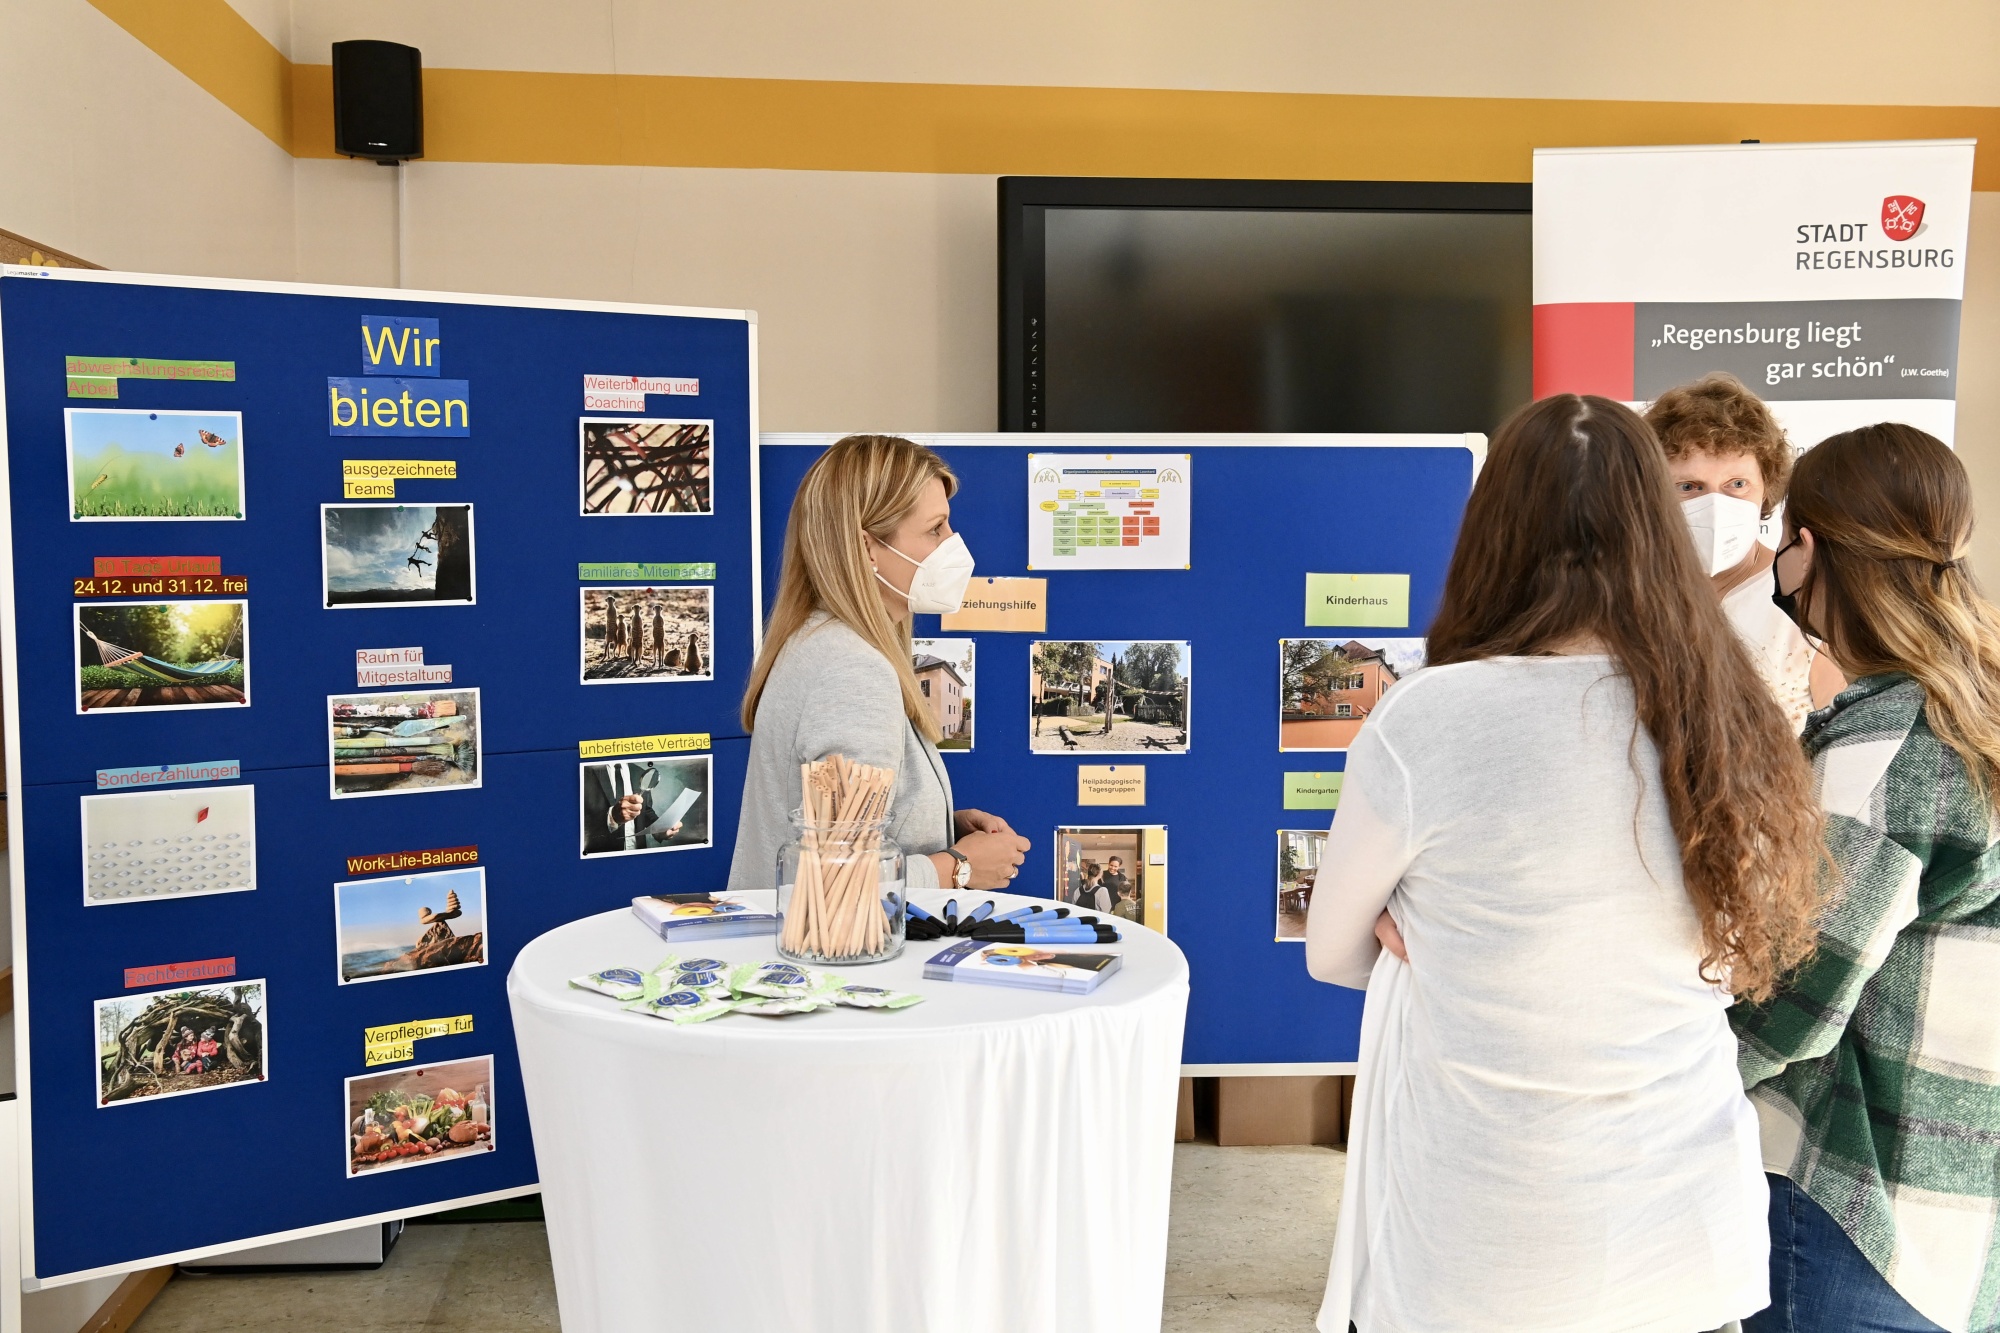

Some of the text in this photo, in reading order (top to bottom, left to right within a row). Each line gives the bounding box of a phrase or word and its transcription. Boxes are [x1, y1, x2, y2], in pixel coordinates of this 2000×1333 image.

[1796, 223, 1868, 244] STADT
[1796, 248, 1954, 271] REGENSBURG
[1651, 321, 1862, 350] „Regensburg liegt
[361, 325, 440, 367] Wir
[66, 360, 235, 380] abwechslungsreiche
[1765, 359, 1806, 385] gar
[1811, 355, 1895, 379] schön“
[1920, 367, 1950, 378] Goethe)
[67, 381, 119, 397] Arbeit
[584, 376, 699, 394] Weiterbildung und
[331, 387, 469, 428] bieten
[584, 396, 645, 412] Coaching
[344, 462, 457, 478] ausgezeichnete
[344, 482, 395, 495] Teams
[94, 560, 221, 577] 30 Tage Urlaub
[579, 565, 716, 578] familiäres Miteinander
[74, 578, 248, 594] 24.12. und 31.12. frei
[1326, 595, 1389, 606] Kinderhaus
[357, 649, 424, 664] Raum für
[357, 668, 452, 686] Mitgestaltung
[580, 736, 711, 756] unbefristete Verträge
[97, 765, 240, 787] Sonderzahlungen
[1082, 778, 1141, 786] Heilpädagogische
[1088, 786, 1136, 794] Tagesgruppen
[1296, 787, 1339, 795] Kindergarten
[347, 849, 478, 873] Work-Life-Balance
[124, 962, 236, 985] Fachberatung
[365, 1018, 474, 1043] Verpflegung für
[366, 1046, 413, 1063] Azubis
